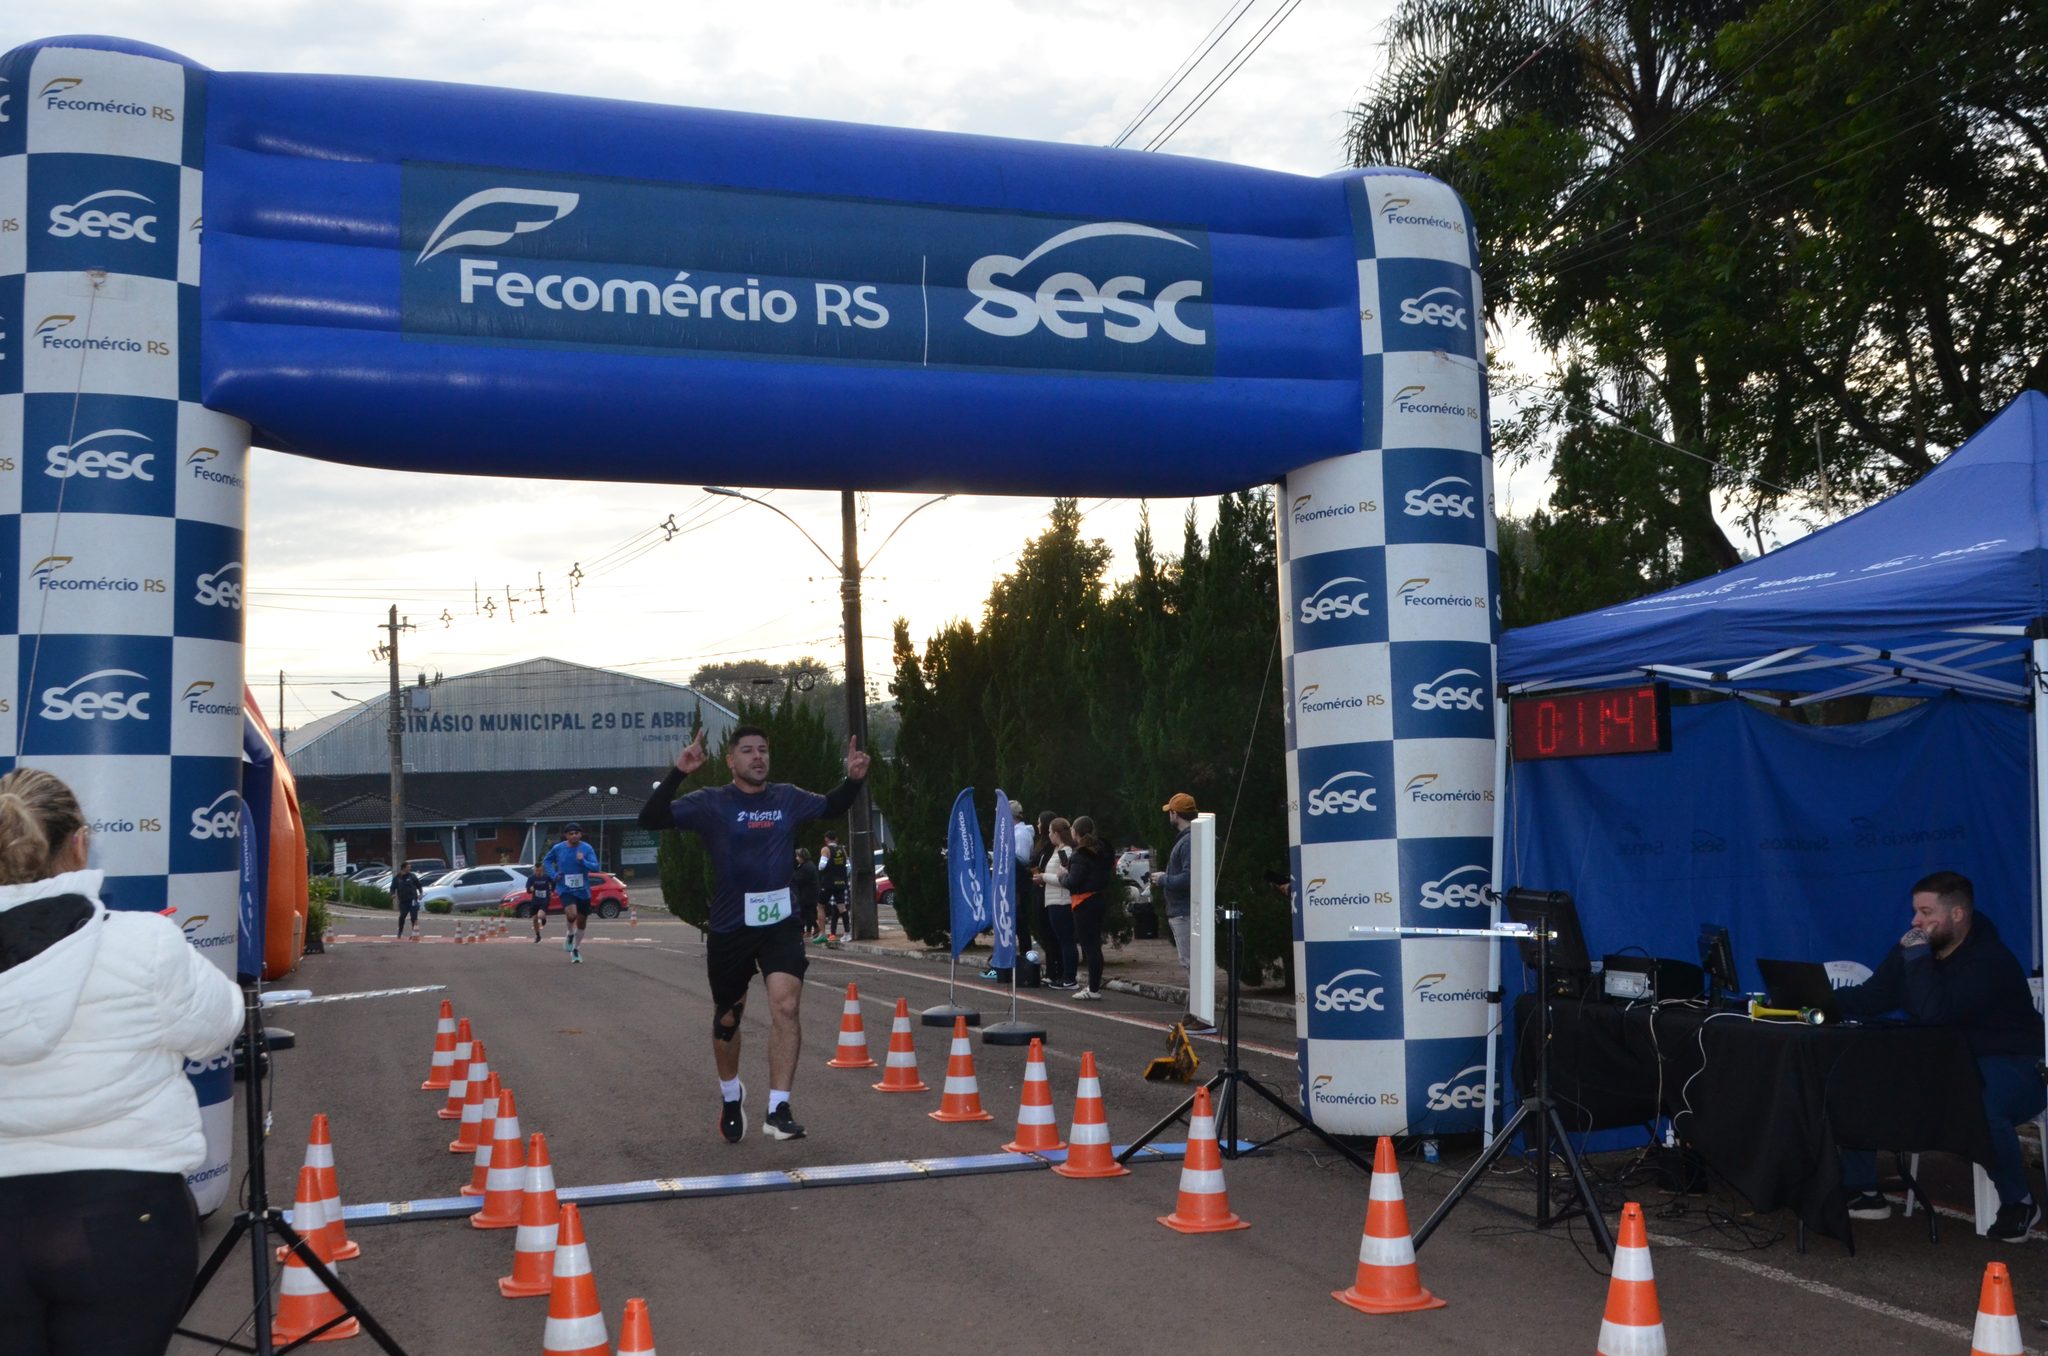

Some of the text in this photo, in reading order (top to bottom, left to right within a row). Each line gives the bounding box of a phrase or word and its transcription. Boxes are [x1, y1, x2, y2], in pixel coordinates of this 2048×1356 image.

[47, 97, 175, 122] Fecomércio RS
[2, 218, 19, 232] RS
[47, 204, 157, 243] Sesc
[1388, 214, 1464, 234] Fecomércio RS
[460, 256, 890, 330] Fecomércio RS
[964, 255, 1206, 346] Sesc
[1400, 298, 1467, 330] Sesc
[42, 335, 170, 356] Fecomércio RS
[1400, 402, 1478, 420] Fecomércio RS
[44, 444, 155, 481] Sesc
[1295, 501, 1377, 524] Fecomércio RS
[1403, 489, 1475, 519] Sesc
[39, 577, 166, 593] Fecomércio RS
[194, 573, 242, 608] Ses
[1300, 592, 1369, 624] Sesc
[1404, 594, 1472, 608] Fecomércio
[1474, 597, 1485, 609] RS
[39, 686, 150, 721] Sesc
[1302, 696, 1362, 714] Fecomércio
[1366, 694, 1385, 706] RS
[1411, 683, 1484, 711] Sesc
[479, 712, 584, 732] MUNICIPAL
[591, 712, 616, 730] 29
[621, 711, 645, 730] DE
[1308, 787, 1377, 816] Sesc
[1412, 789, 1494, 802] Fecomércio RS
[139, 819, 161, 832] RS
[570, 879, 580, 887] 78
[1309, 892, 1370, 906] Fecomércio
[1374, 891, 1392, 904] RS
[758, 903, 780, 922] 84
[1315, 984, 1384, 1012] Sesc
[1315, 1092, 1376, 1106] Fecomércio
[1380, 1094, 1399, 1105] RS
